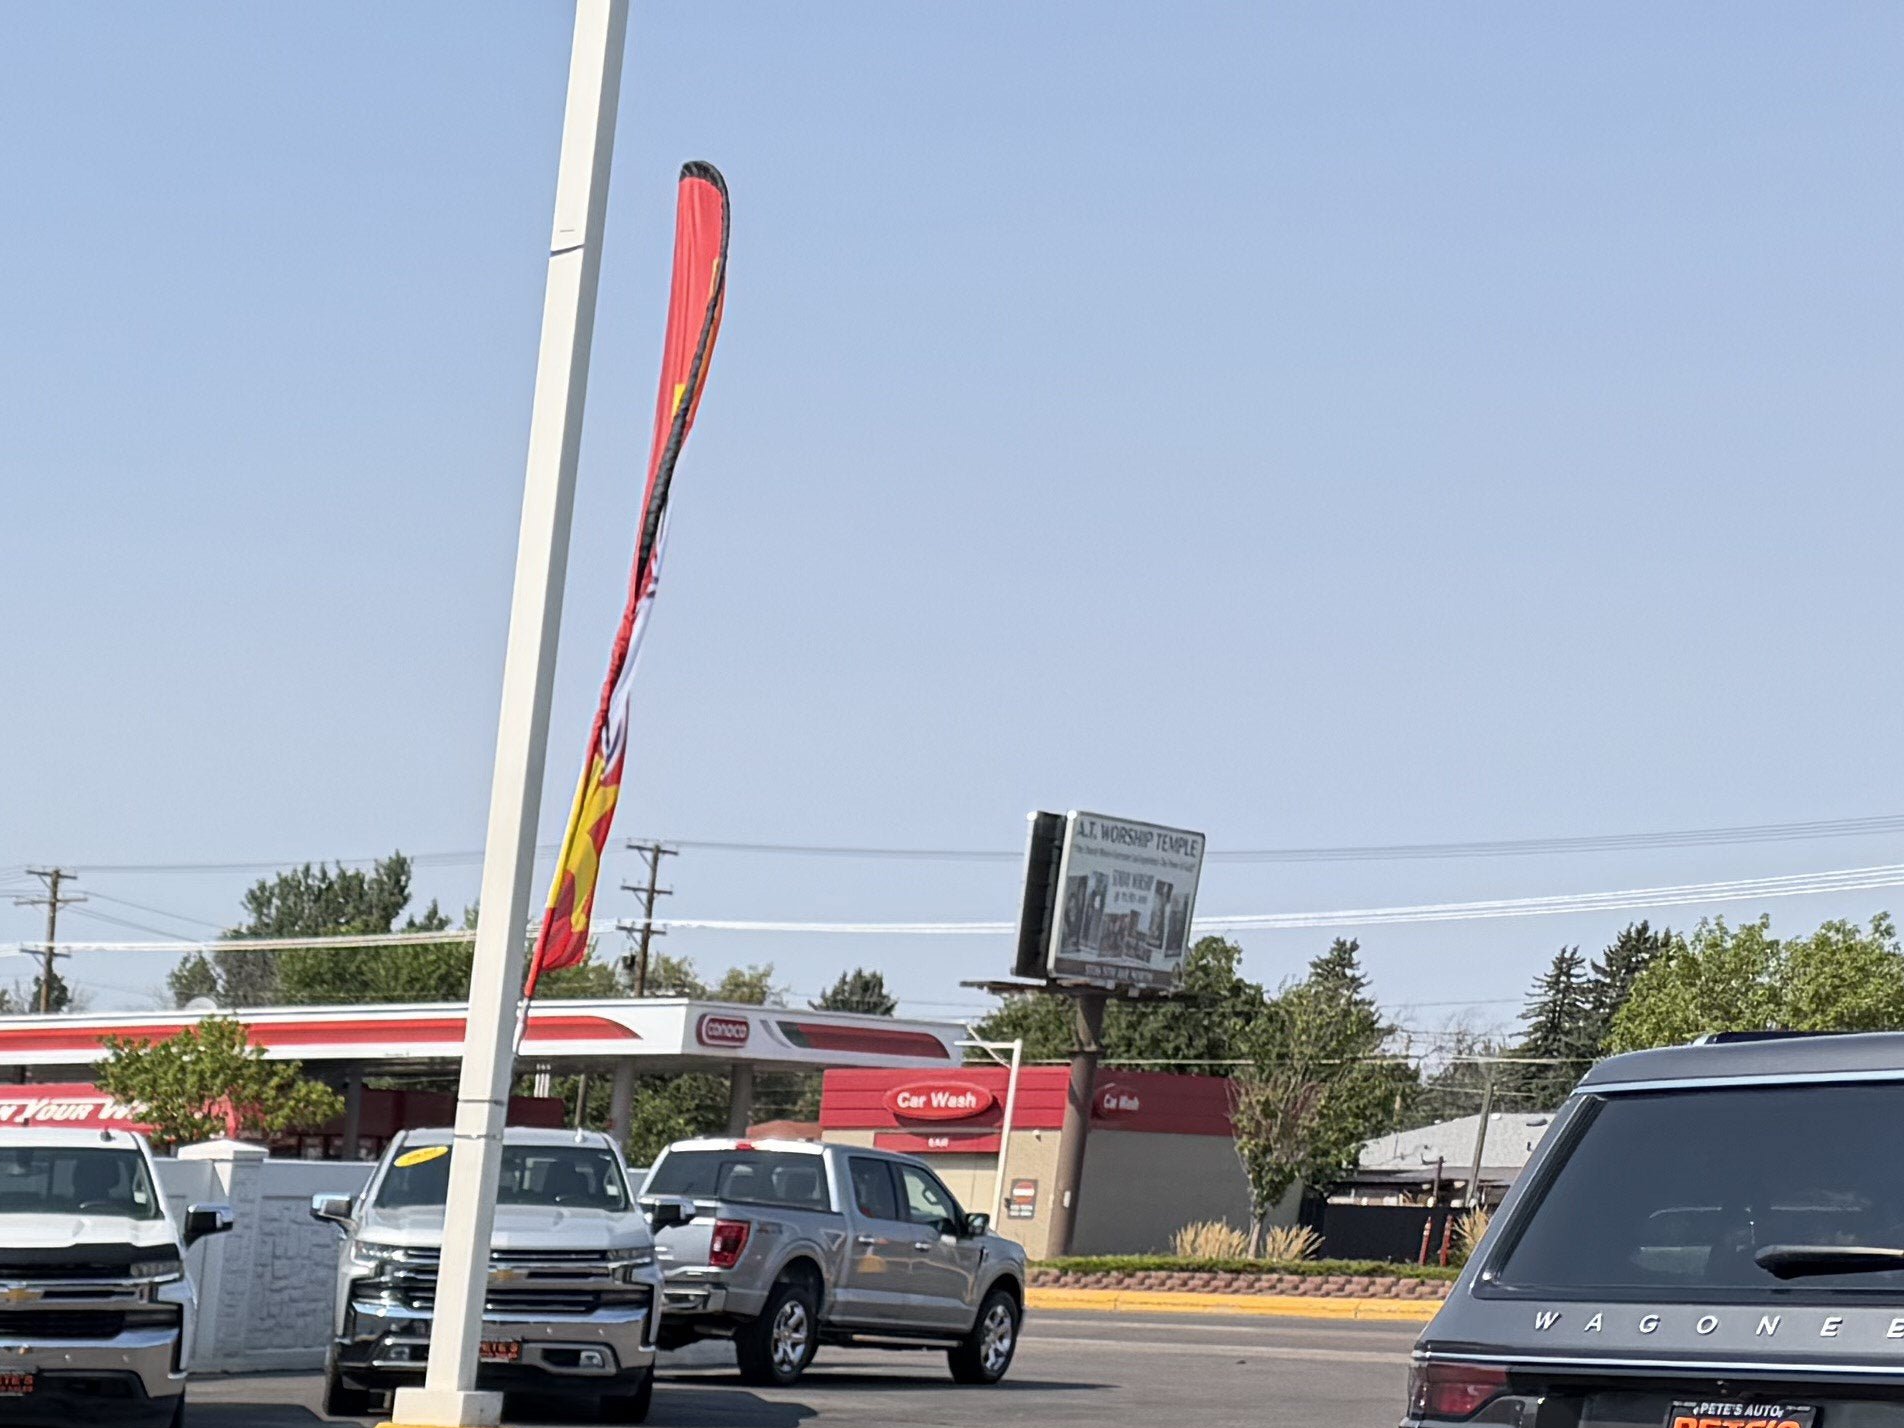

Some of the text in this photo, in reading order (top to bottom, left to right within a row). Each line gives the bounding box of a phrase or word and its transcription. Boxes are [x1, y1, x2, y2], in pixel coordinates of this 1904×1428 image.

[1101, 823, 1154, 848] WORSHIP
[1155, 832, 1199, 858] TEMPLE
[16, 1097, 94, 1124] YOUR
[896, 1091, 977, 1109] Car Wash
[1699, 1402, 1743, 1416] PETE'S
[1744, 1404, 1780, 1417] AUTO
